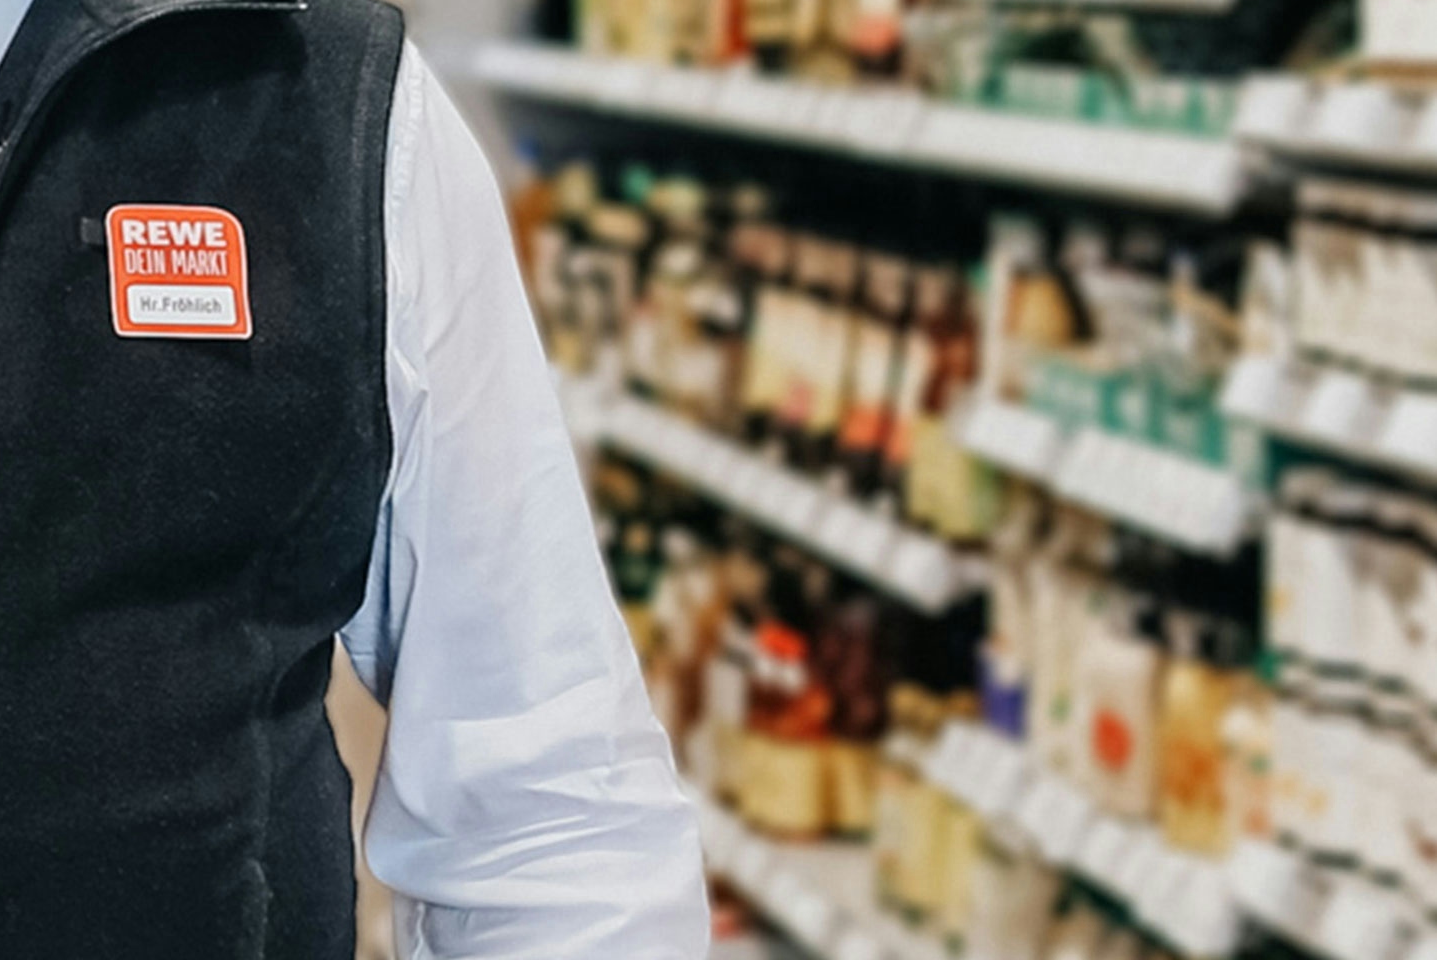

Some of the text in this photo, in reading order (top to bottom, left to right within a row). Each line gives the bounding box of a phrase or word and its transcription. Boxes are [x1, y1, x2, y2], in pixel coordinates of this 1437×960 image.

[121, 219, 227, 247] REWE
[124, 248, 228, 276] DEIN MARKT
